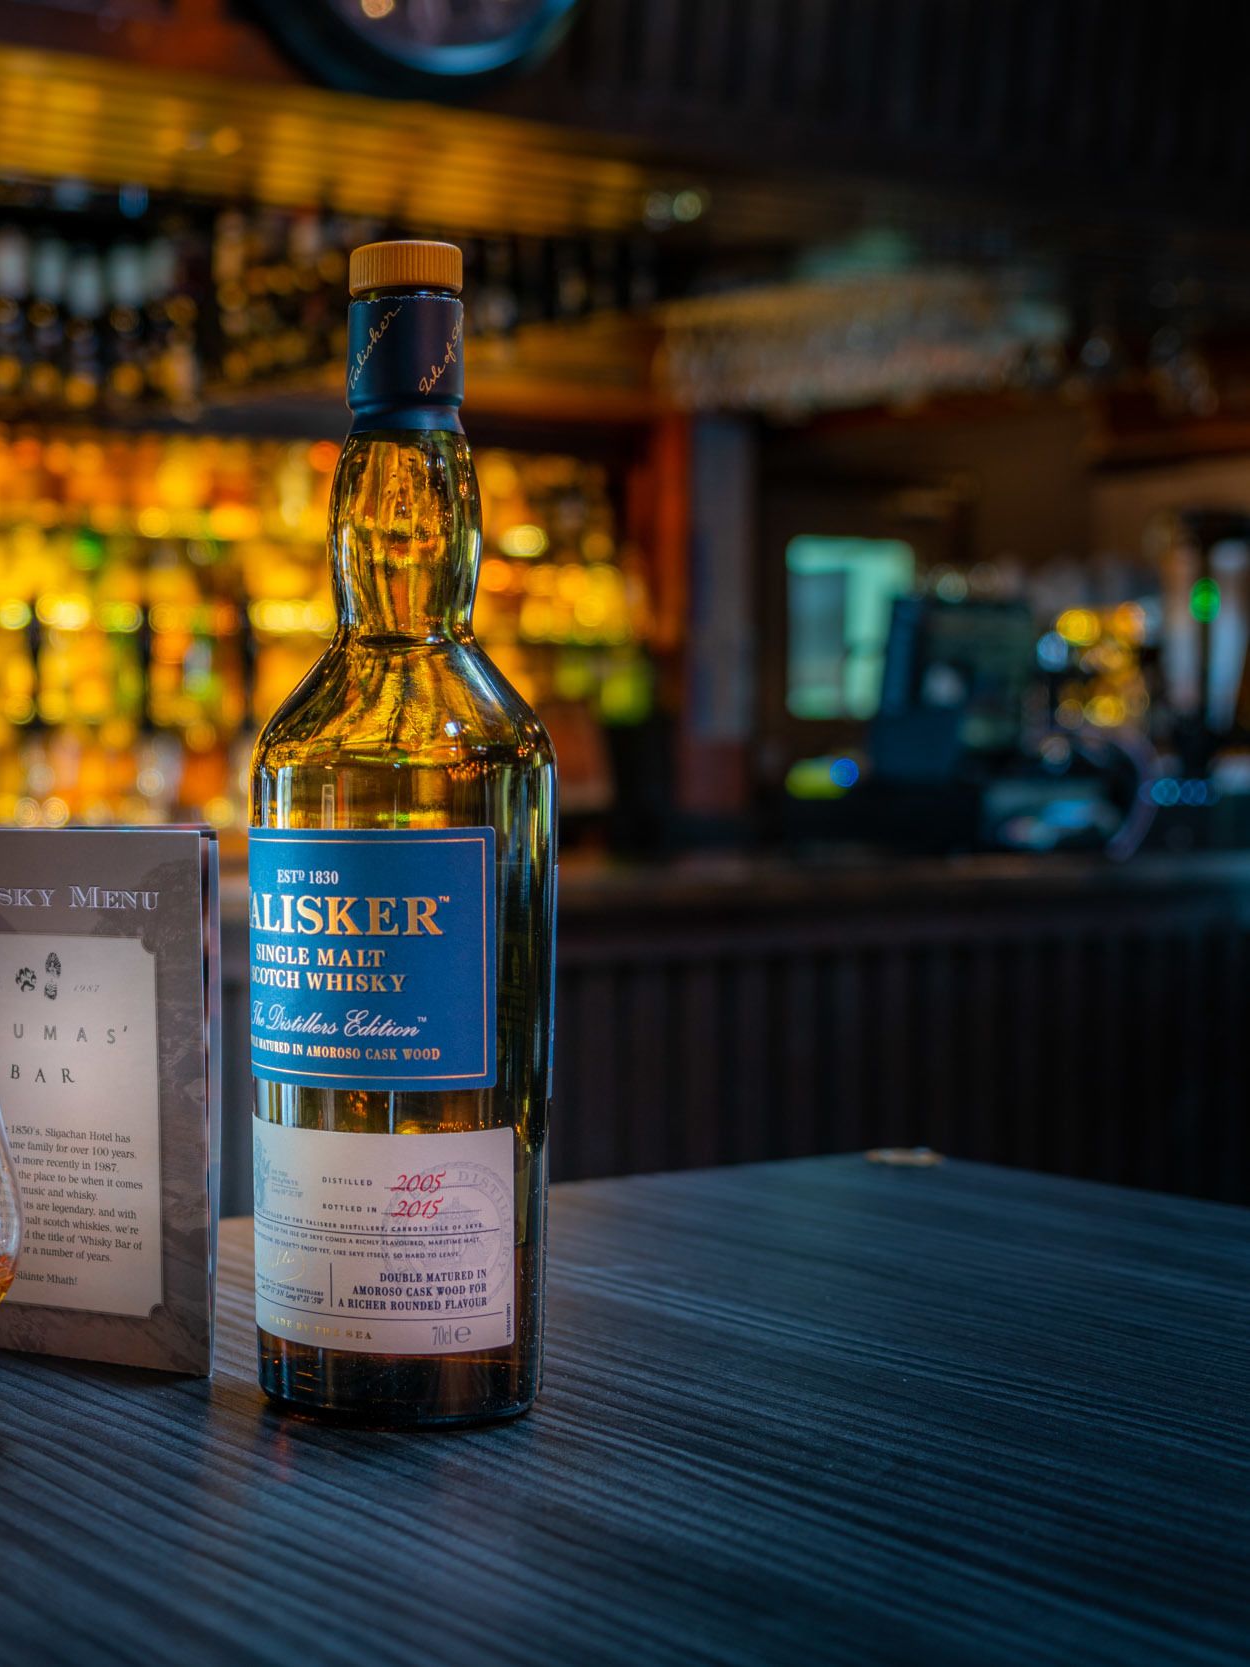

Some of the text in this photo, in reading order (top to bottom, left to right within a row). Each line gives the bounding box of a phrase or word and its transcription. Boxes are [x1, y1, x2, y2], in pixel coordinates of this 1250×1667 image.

[309, 869, 339, 885] 1830
[256, 944, 386, 968] SINGLE MALT
[252, 965, 407, 993] SCOTCH WHISKY
[265, 1003, 338, 1036] Distillers
[292, 1043, 303, 1056] IN
[306, 1045, 361, 1059] AMOROSO
[365, 1047, 398, 1061] CASK
[402, 1047, 441, 1061] WOOD
[10, 1063, 76, 1085] BAR
[89, 1130, 113, 1142] Hotel
[115, 1132, 131, 1144] has
[27, 1140, 55, 1155] family
[56, 1142, 69, 1154] for
[70, 1146, 89, 1156] over
[91, 1146, 110, 1158] 100
[22, 1156, 44, 1166] more
[46, 1158, 80, 1171] recently
[82, 1159, 91, 1170] in
[18, 1170, 143, 1191] the place to be when it comes
[322, 1170, 447, 1193] DISTILLED 2005
[47, 1188, 64, 1198] and
[36, 1203, 50, 1212] are
[98, 1207, 115, 1218] and
[117, 1209, 137, 1220] with
[322, 1203, 363, 1213] BOTTLED
[390, 1196, 445, 1219] 2015
[43, 1218, 70, 1229] scotch
[114, 1224, 139, 1235] we're
[31, 1230, 46, 1241] the
[47, 1231, 64, 1243] title
[66, 1233, 76, 1244] of
[114, 1239, 132, 1250] Bar
[133, 1240, 143, 1251] of
[324, 1236, 347, 1244] COMES
[33, 1247, 39, 1255] a
[40, 1247, 74, 1259] number
[75, 1249, 85, 1260] of
[46, 1273, 79, 1286] Mhath!
[380, 1268, 488, 1284] DOUBLE MATURED IN
[352, 1282, 488, 1297] AMOROSO CASK WOOD FOR
[338, 1297, 488, 1312] A RICHER ROUNDED FLAVOUR
[345, 1330, 373, 1341] SEA
